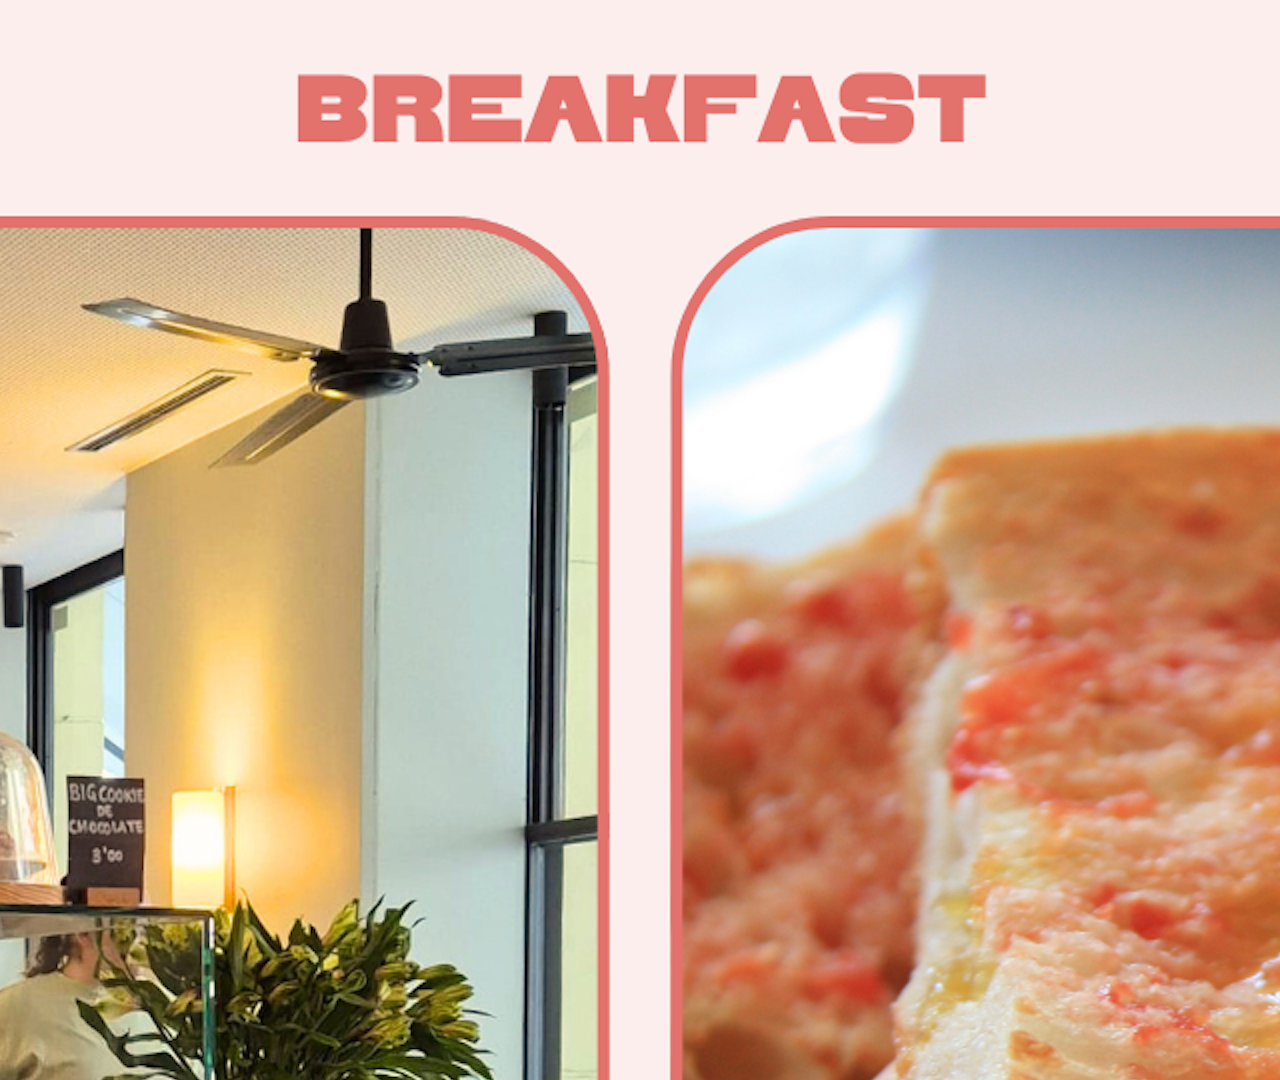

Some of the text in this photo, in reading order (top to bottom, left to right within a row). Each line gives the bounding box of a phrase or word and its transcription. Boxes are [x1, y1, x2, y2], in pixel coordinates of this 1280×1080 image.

[69, 782, 145, 803] BIG COOKIE
[96, 804, 113, 819] DE
[68, 819, 145, 836] CHOCOLATE
